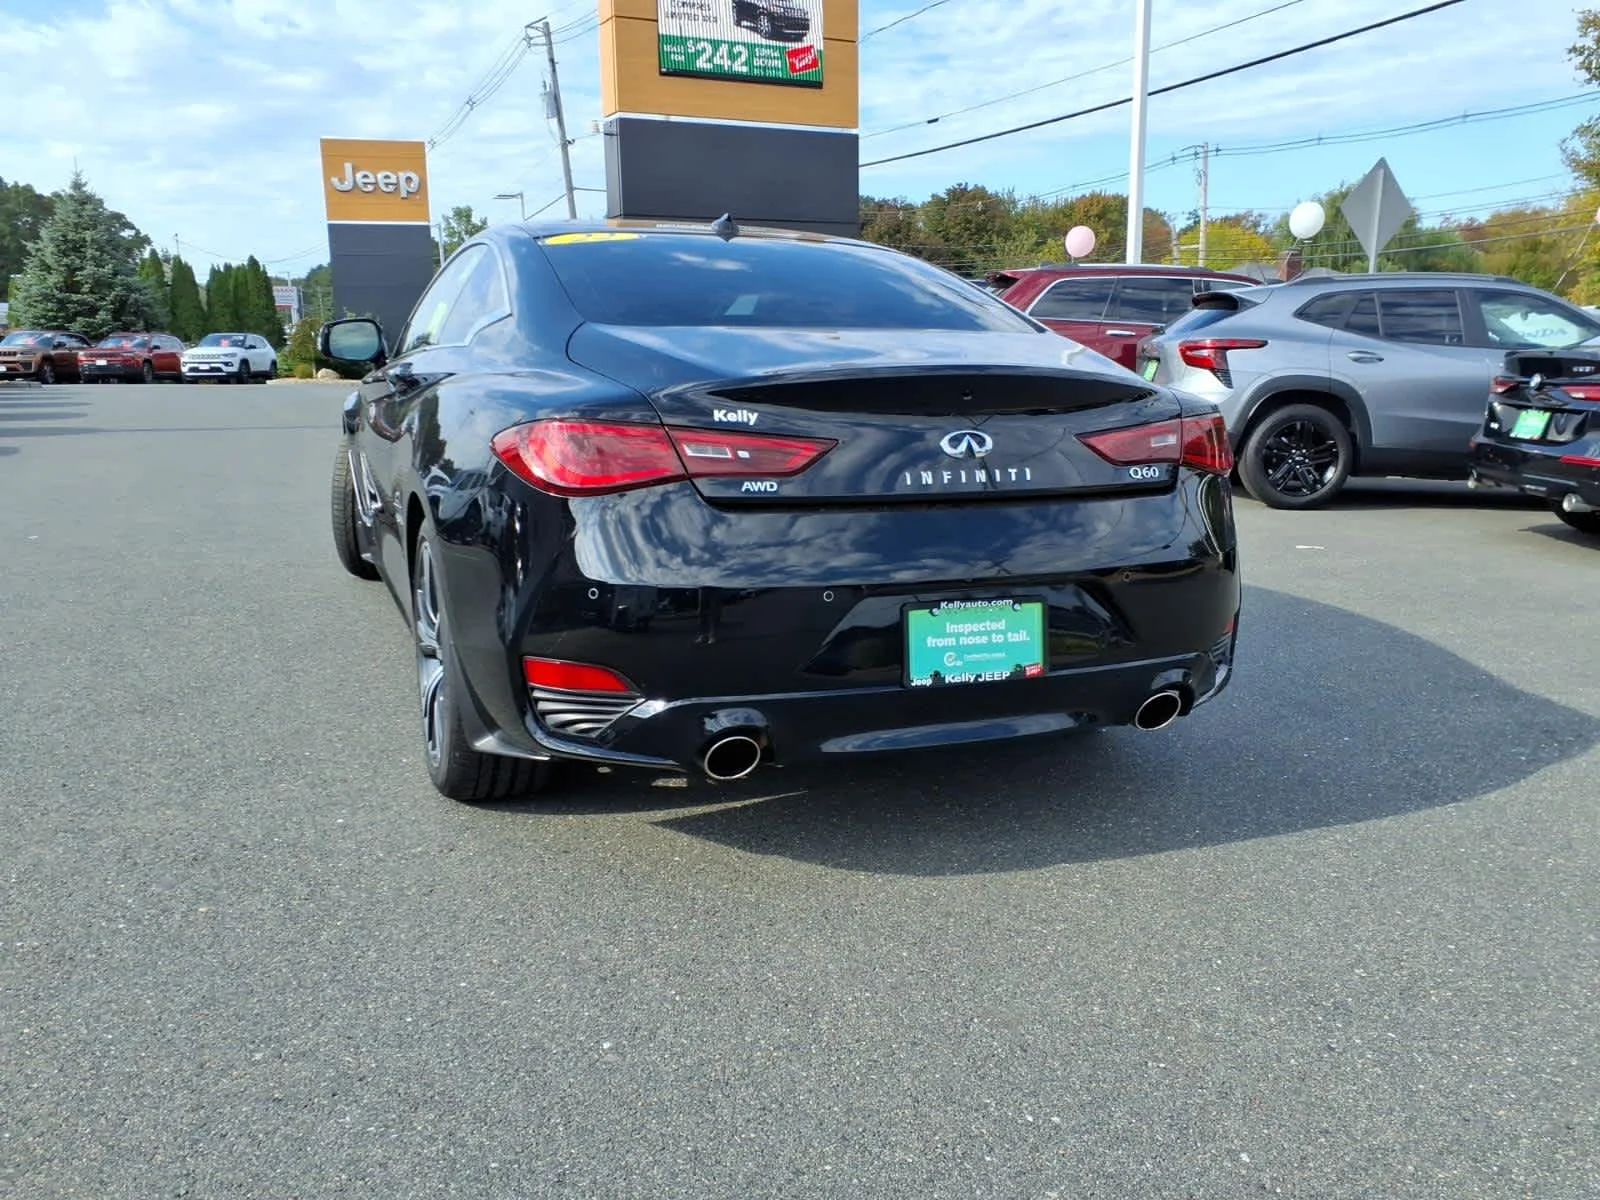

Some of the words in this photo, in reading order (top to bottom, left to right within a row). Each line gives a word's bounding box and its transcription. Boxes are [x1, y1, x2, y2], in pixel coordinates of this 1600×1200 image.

[330, 161, 420, 199] Jeep
[713, 409, 759, 425] Kelly
[905, 467, 1032, 485] INFINITI
[1129, 466, 1160, 479] Q60
[741, 481, 778, 492] AWD
[940, 599, 1014, 609] Kellyauto.com
[945, 619, 1006, 635] Inspected
[927, 636, 956, 648] from
[959, 635, 989, 645] nose
[991, 633, 1004, 643] to
[1007, 630, 1031, 642] tail.
[945, 671, 977, 684] Kelly
[977, 671, 1011, 682] JEEP
